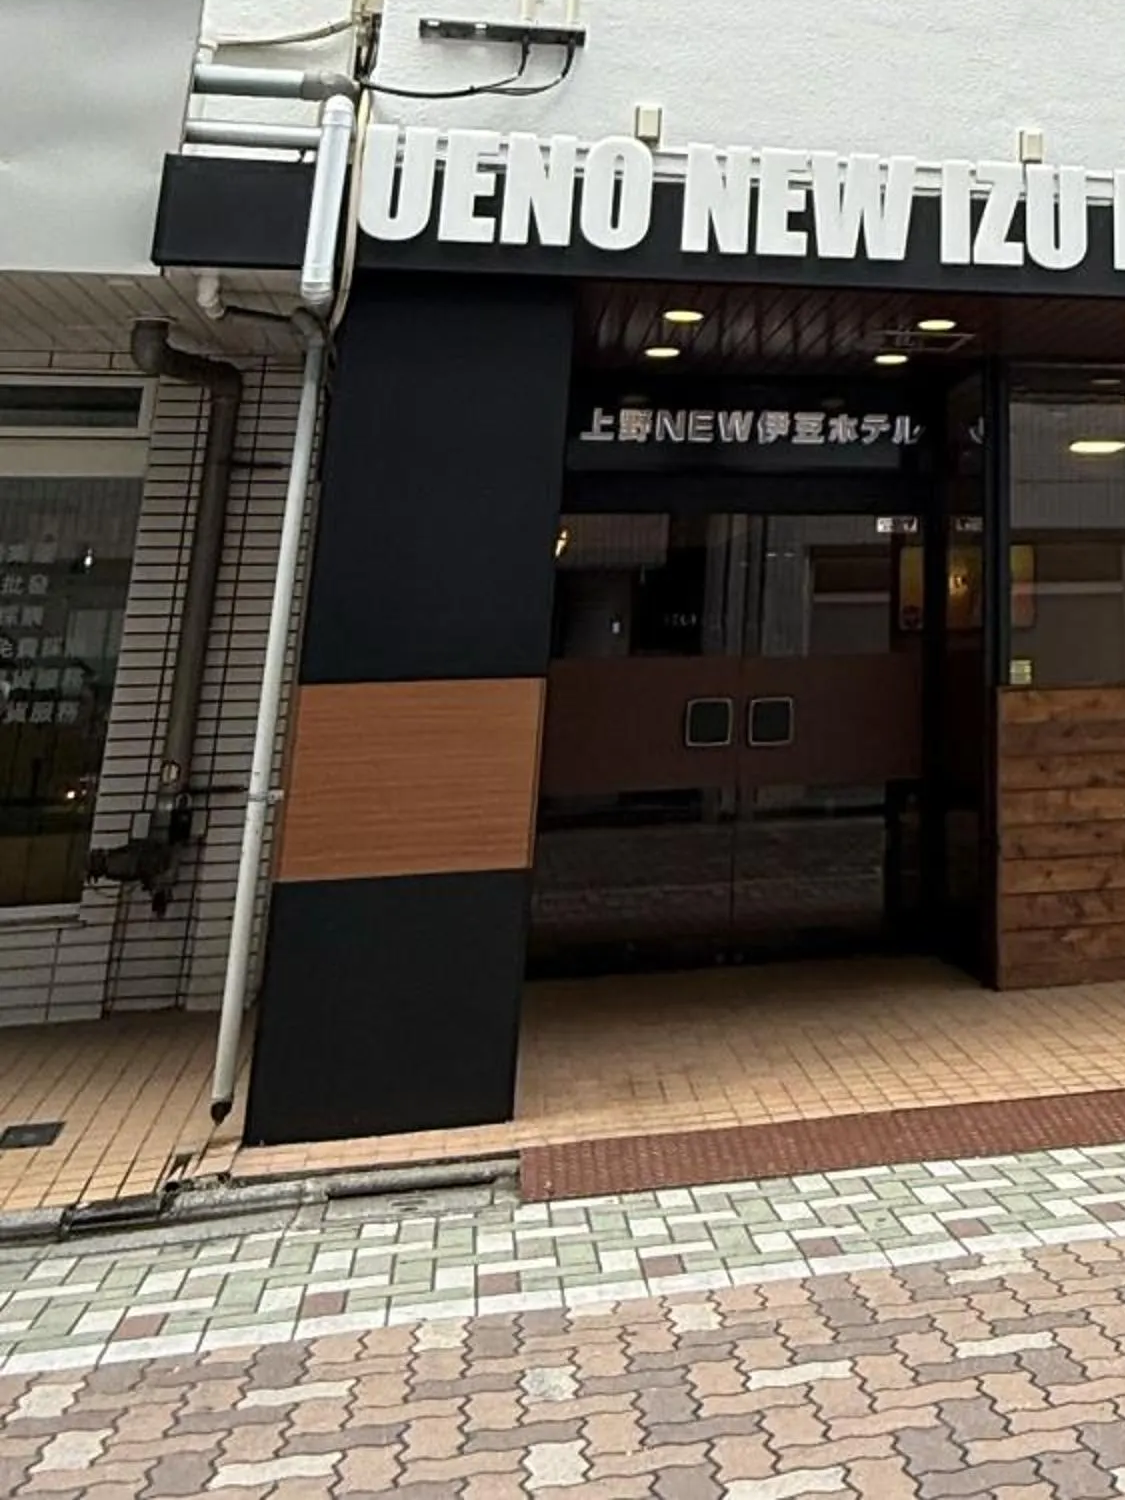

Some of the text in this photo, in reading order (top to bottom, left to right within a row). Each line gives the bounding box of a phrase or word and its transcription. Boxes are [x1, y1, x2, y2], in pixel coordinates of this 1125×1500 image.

[358, 124, 653, 250] UENO
[679, 142, 919, 262] NEW
[941, 159, 1089, 270] IZU
[579, 406, 922, 446] 上野NEW伊豆ホテル
